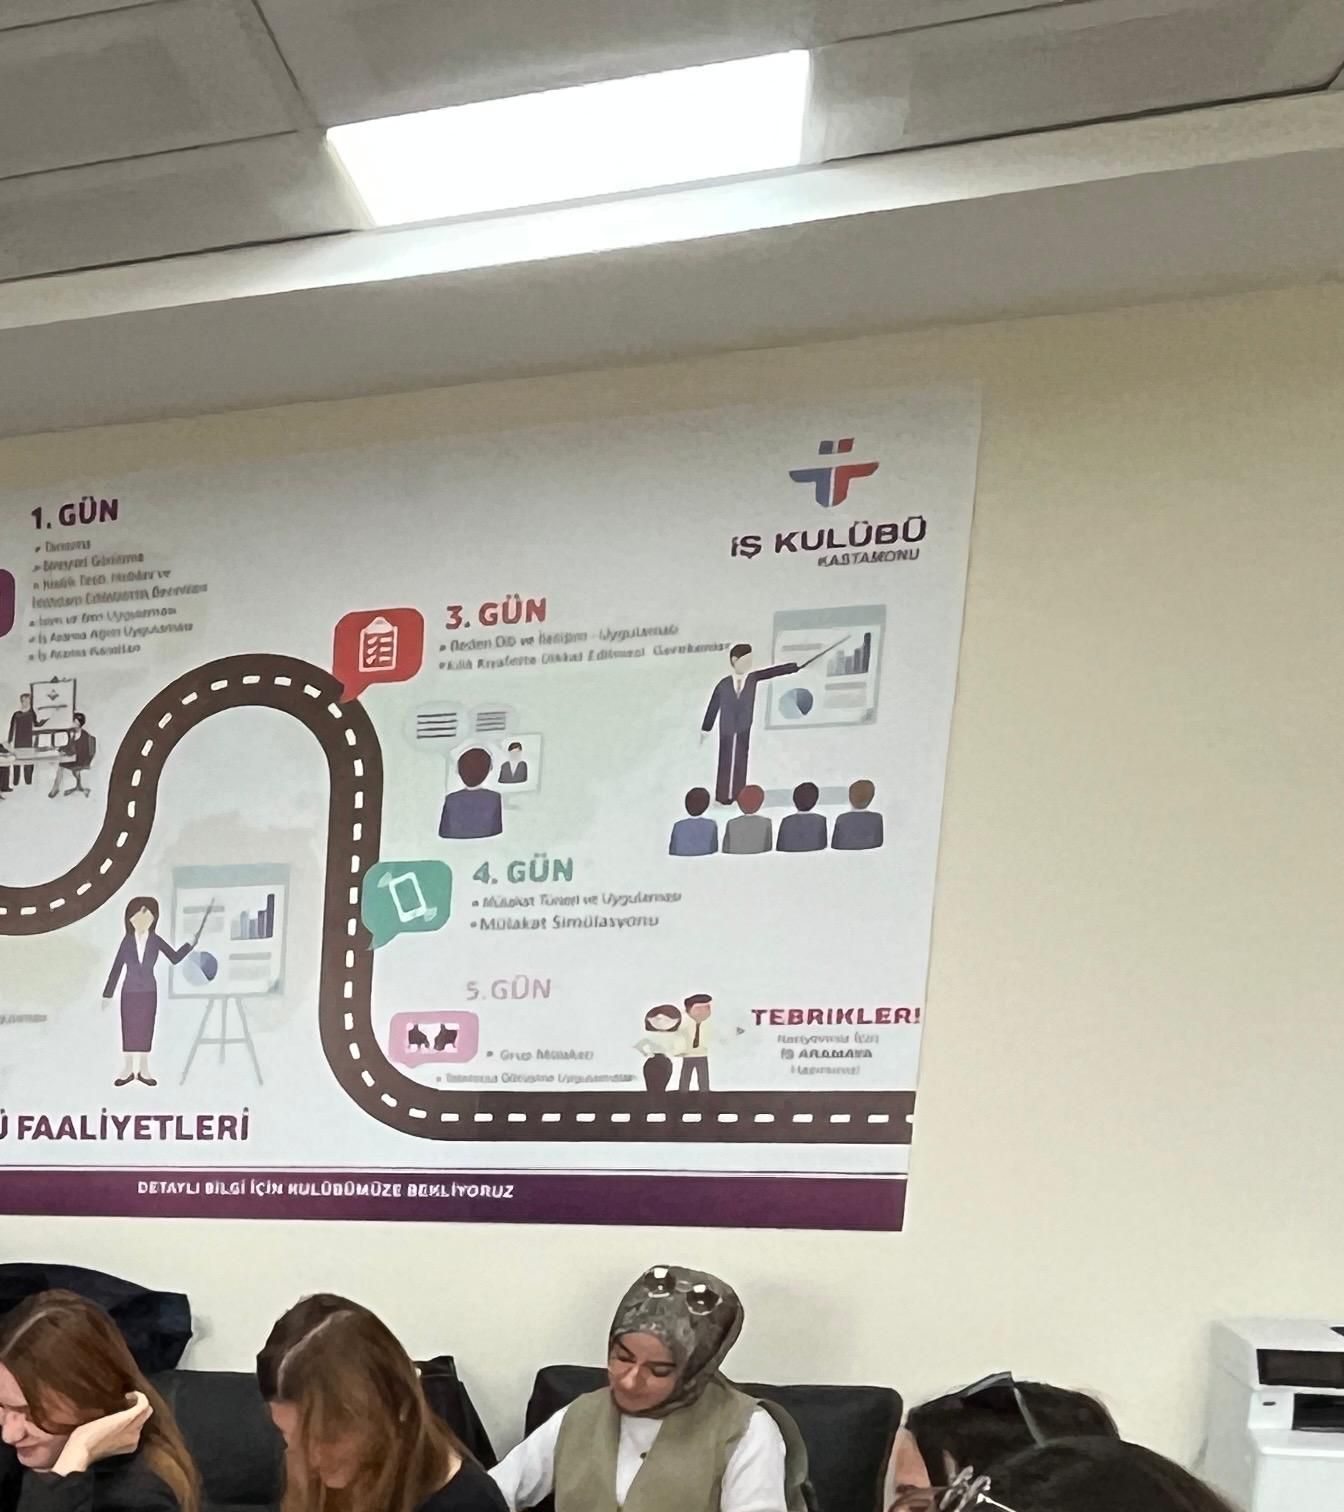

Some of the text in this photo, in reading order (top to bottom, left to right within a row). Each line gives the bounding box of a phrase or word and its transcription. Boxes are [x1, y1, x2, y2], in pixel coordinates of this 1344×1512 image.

[31, 495, 119, 529] 1. GÜN
[774, 514, 927, 554] KULÜBÜ
[817, 547, 920, 567] KASTAMONU
[445, 593, 547, 629] 3. GÜN
[472, 852, 574, 885] 4. GÜN
[480, 914, 659, 931] Mülakat Simülasyonu
[466, 974, 552, 1001] 5. GÜN
[16, 1107, 250, 1141] FAALİYETLERİ
[137, 1178, 515, 1199] DETAYLI BİLGİ İÇİN KULÜBÜMÜZE BEKLİYORUZ
